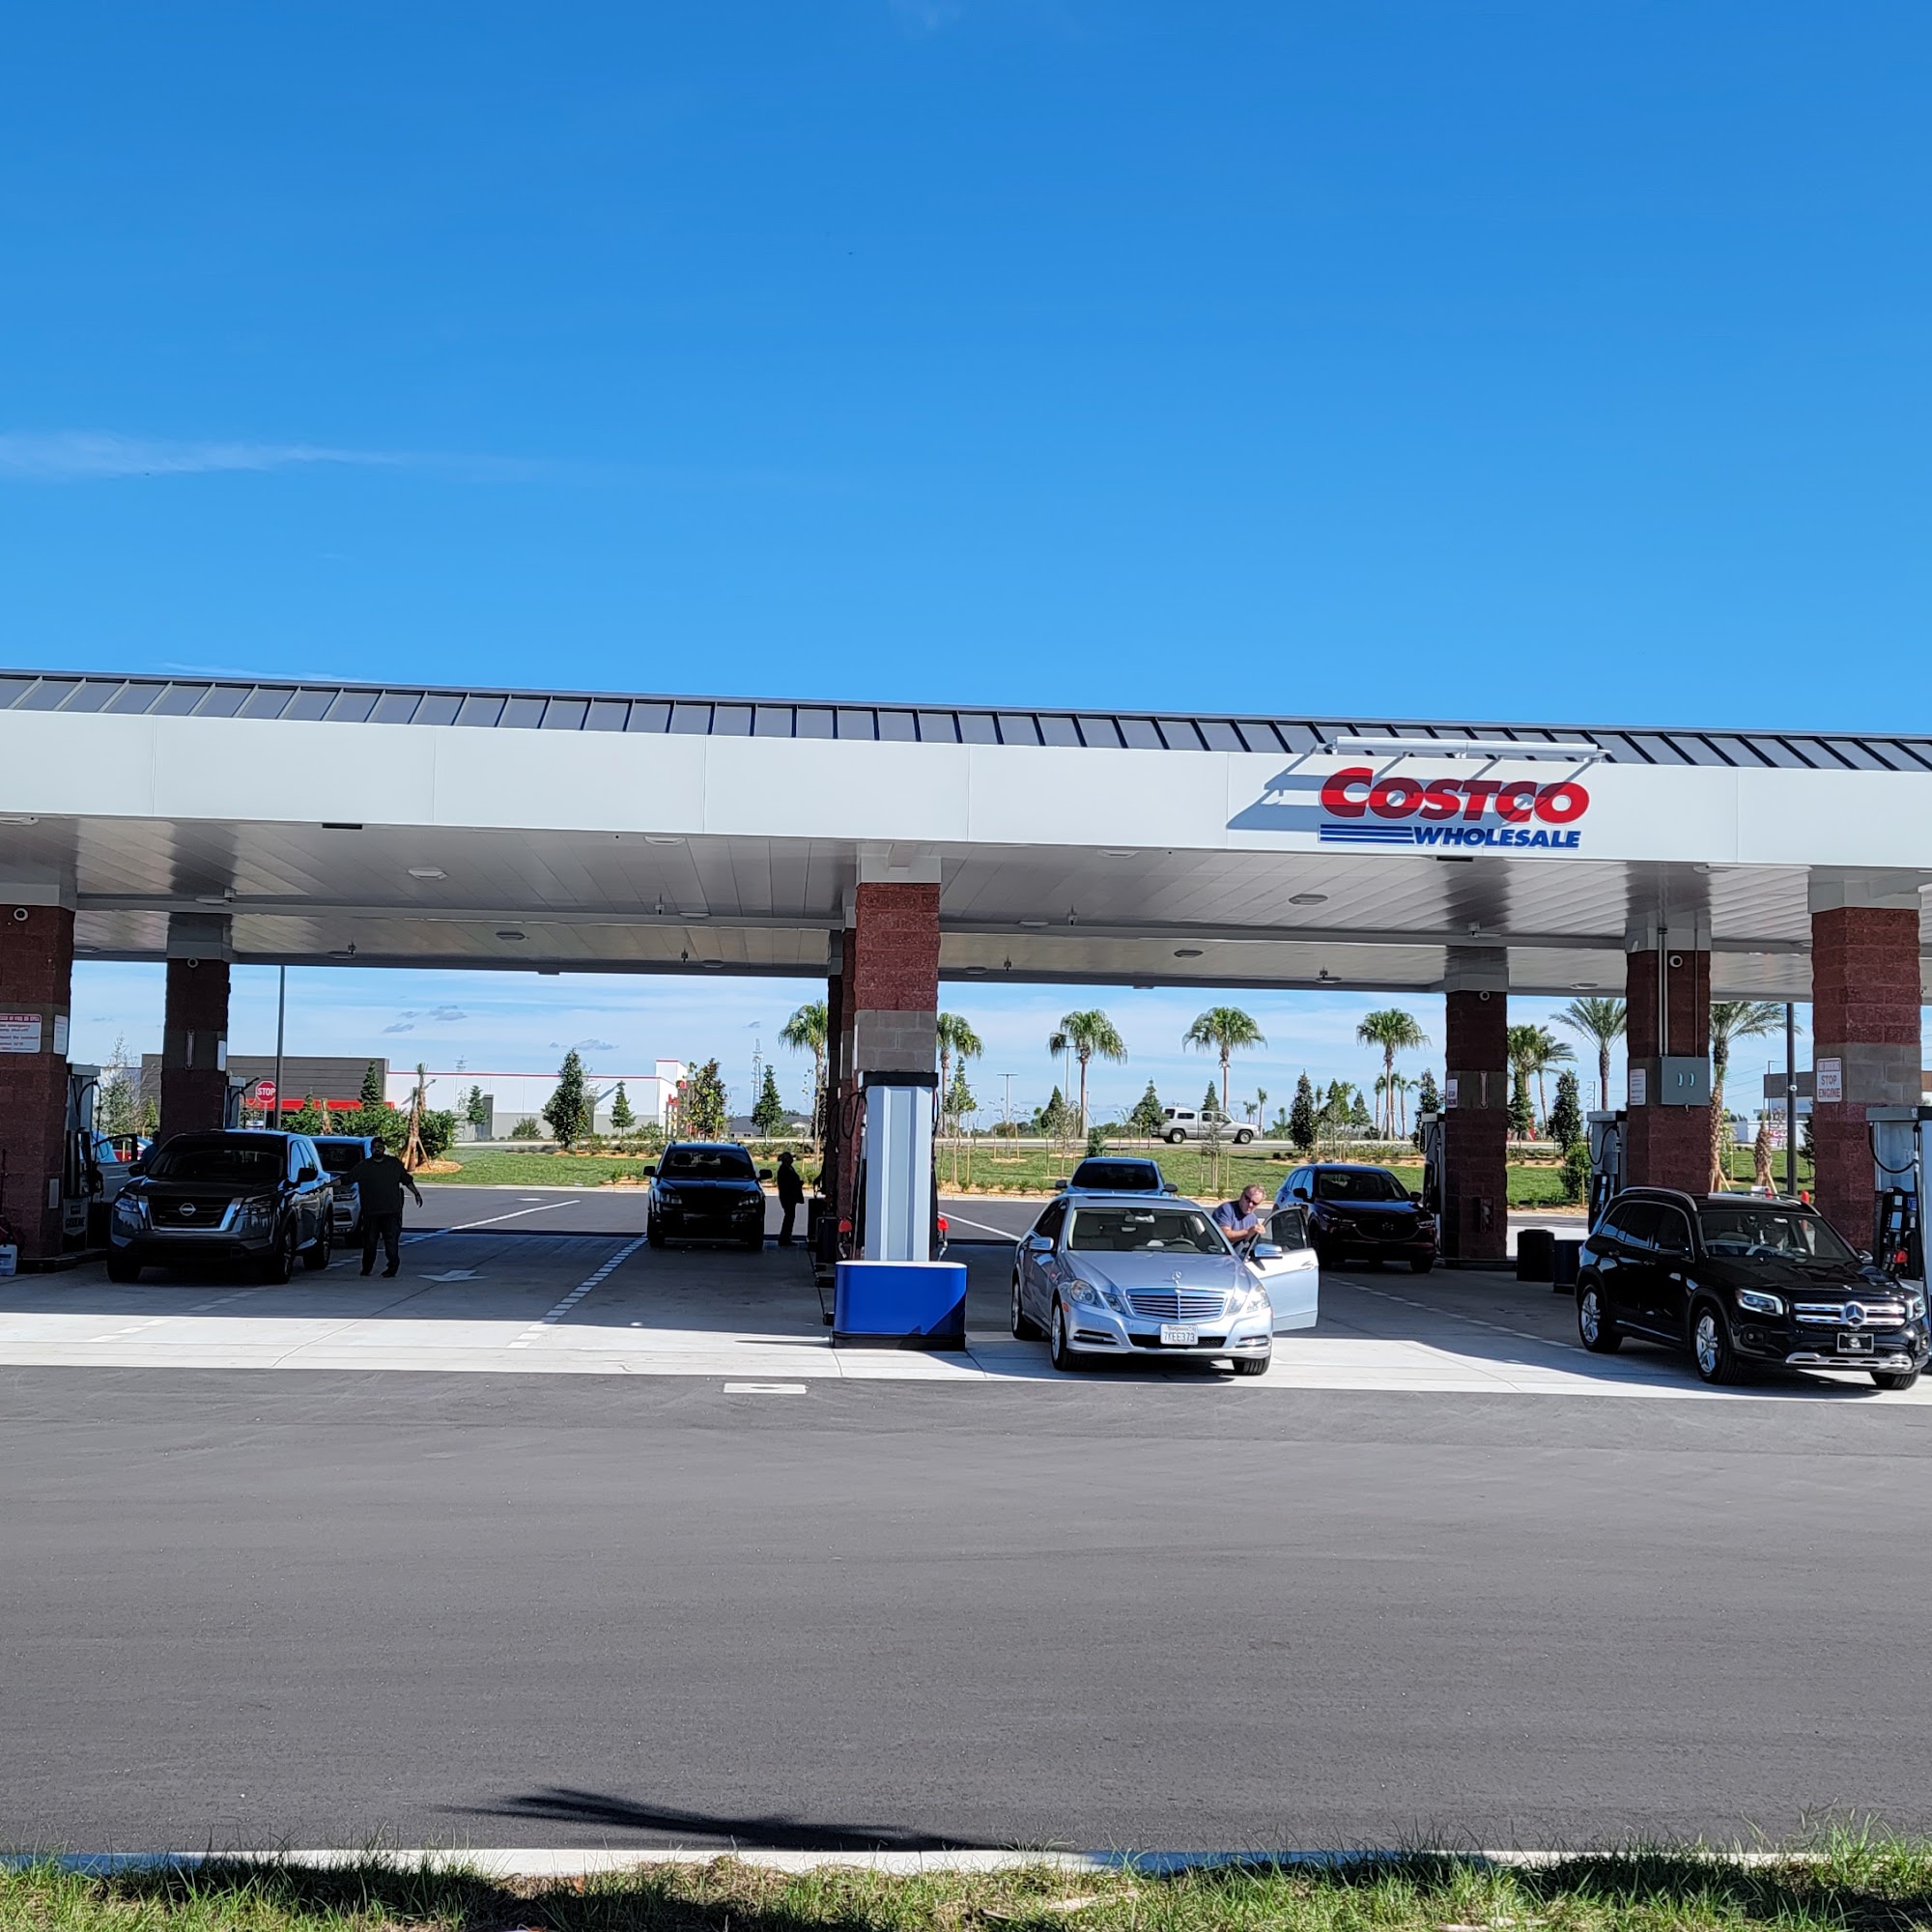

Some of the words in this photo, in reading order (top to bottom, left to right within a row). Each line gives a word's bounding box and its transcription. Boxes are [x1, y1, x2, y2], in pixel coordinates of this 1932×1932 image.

[1321, 767, 1590, 824] COSTCO
[1413, 826, 1582, 848] WHOLESALE
[1821, 1074, 1837, 1086] STOP
[257, 1087, 276, 1096] STOP
[1818, 1088, 1841, 1098] ENGINE
[1163, 1331, 1196, 1342] 7KEE373
